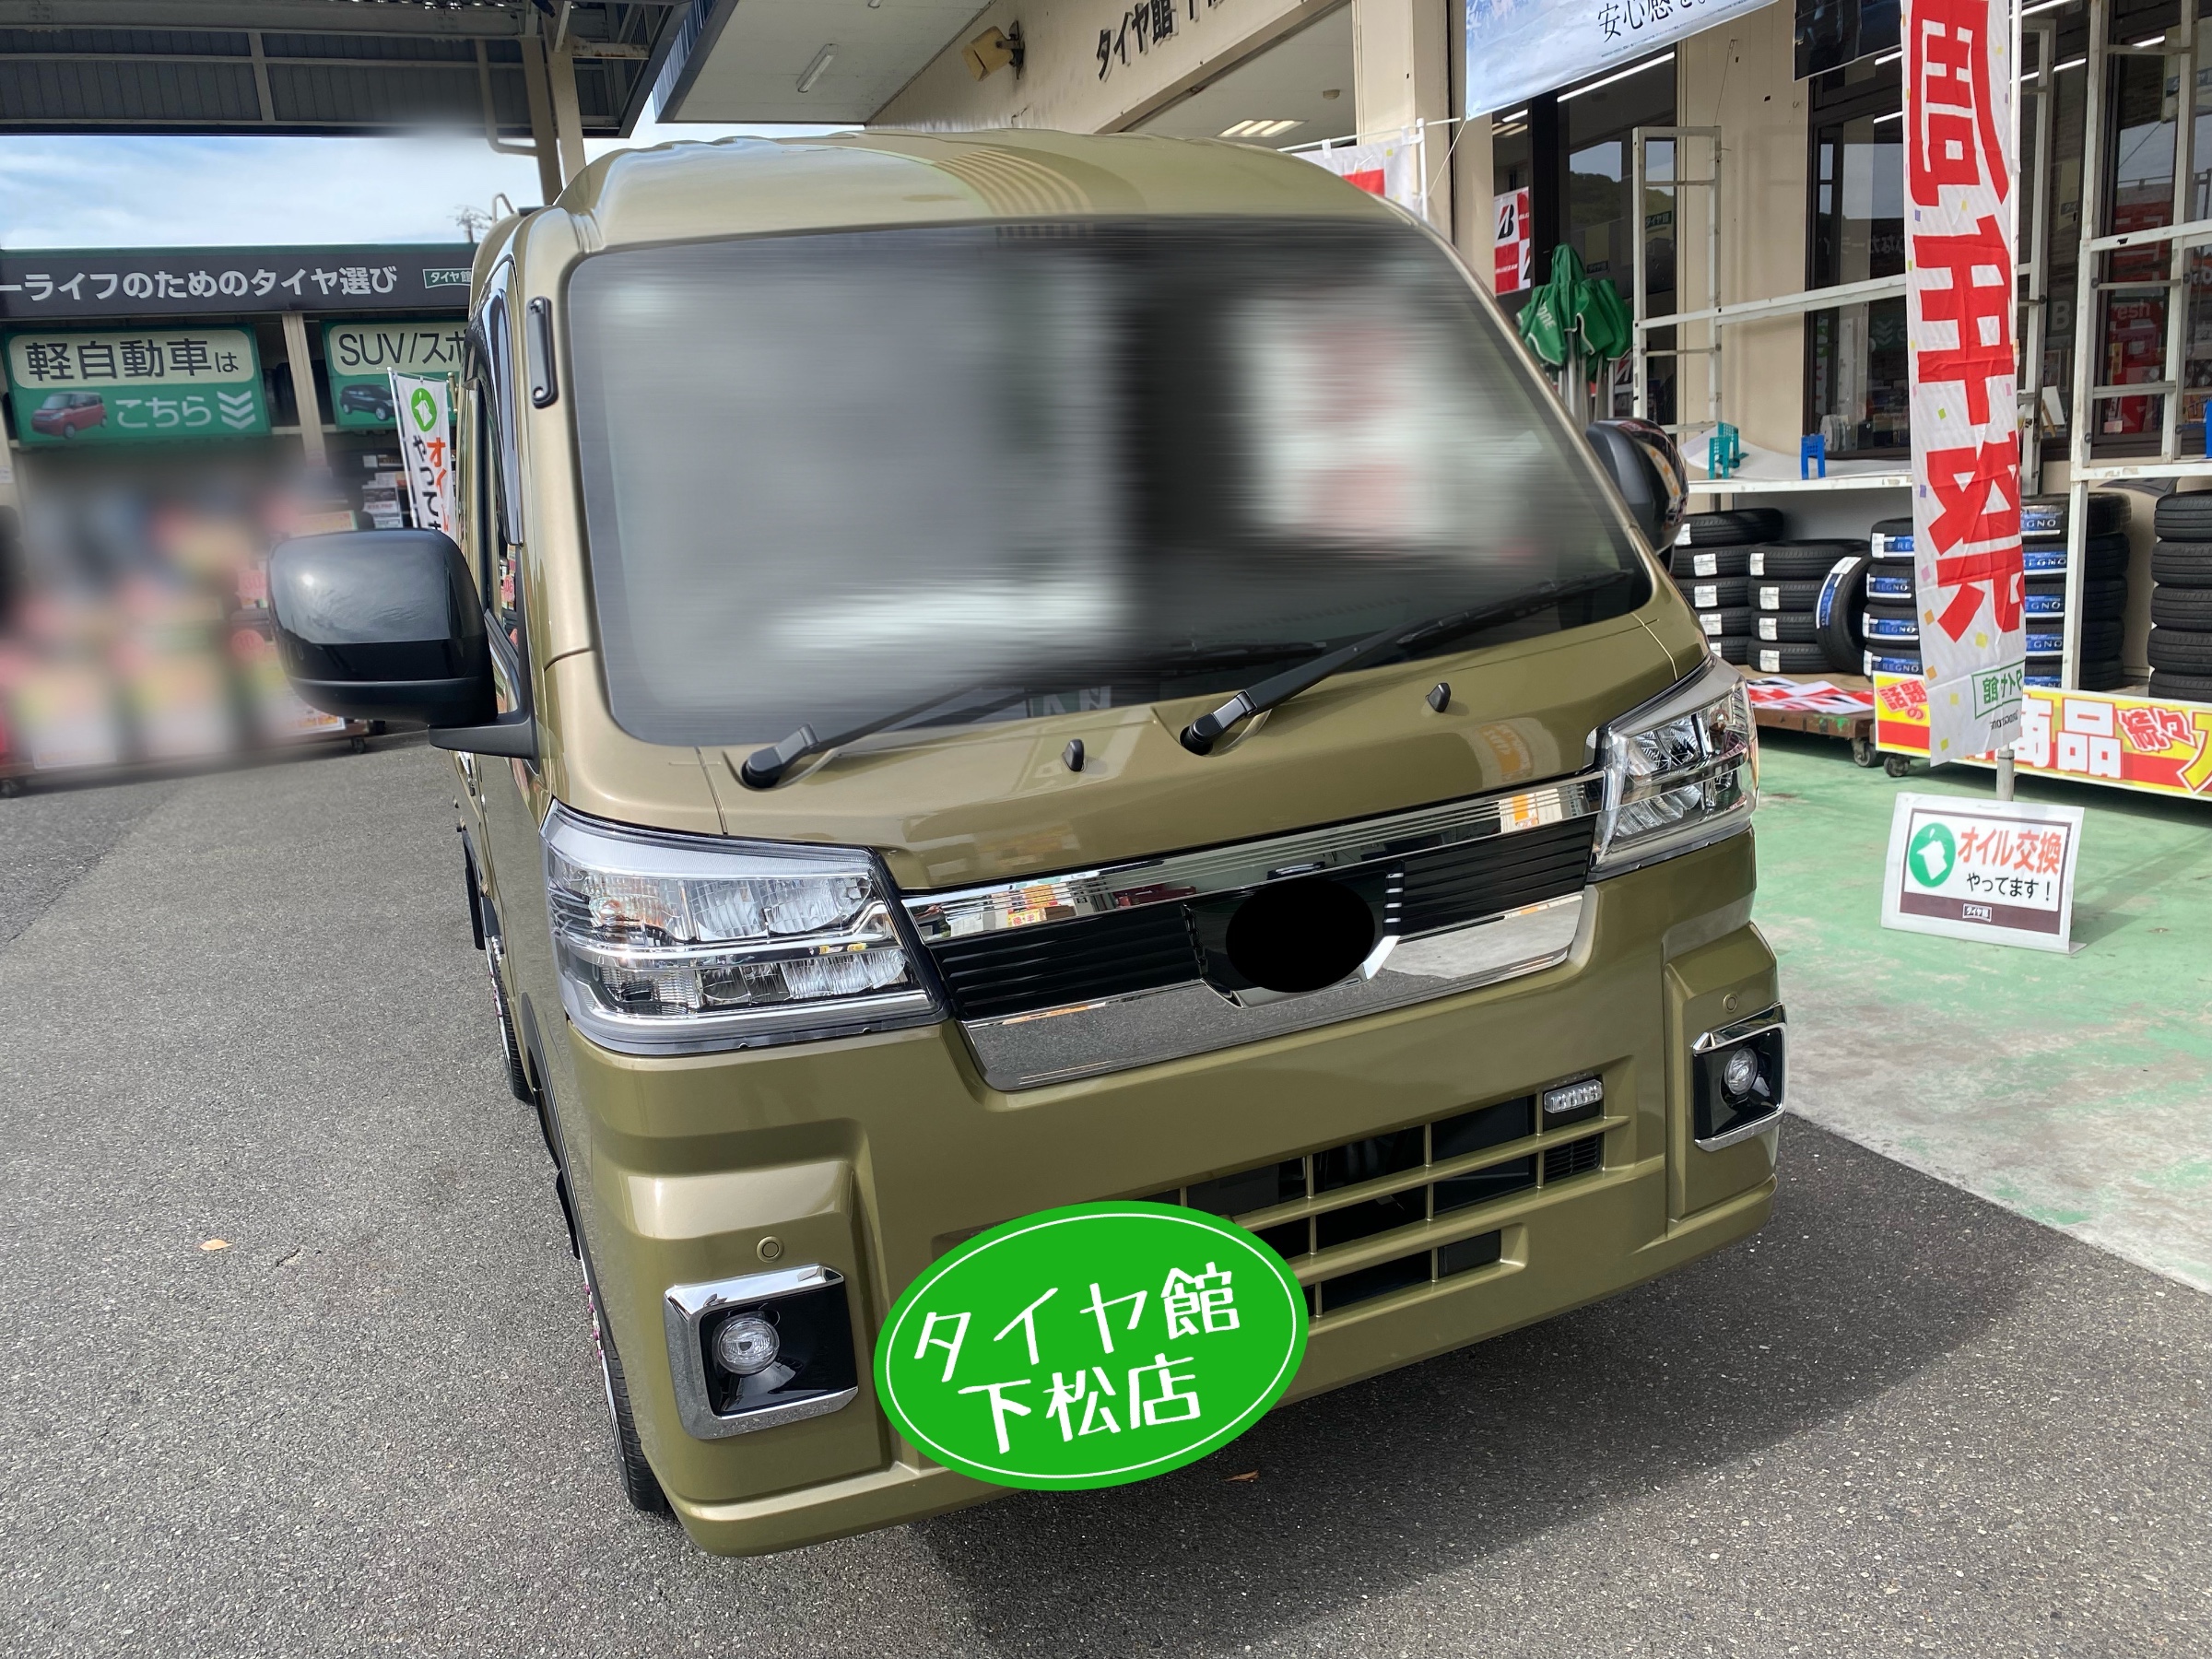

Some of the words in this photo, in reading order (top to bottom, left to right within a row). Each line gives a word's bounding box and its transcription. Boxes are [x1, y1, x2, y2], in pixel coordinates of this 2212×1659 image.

[25, 338, 240, 381] 軽自動車は
[115, 395, 212, 428] こちら
[1882, 664, 1919, 673] REGNO
[1958, 827, 2062, 875] オイル交換
[1967, 873, 2052, 901] やってます！
